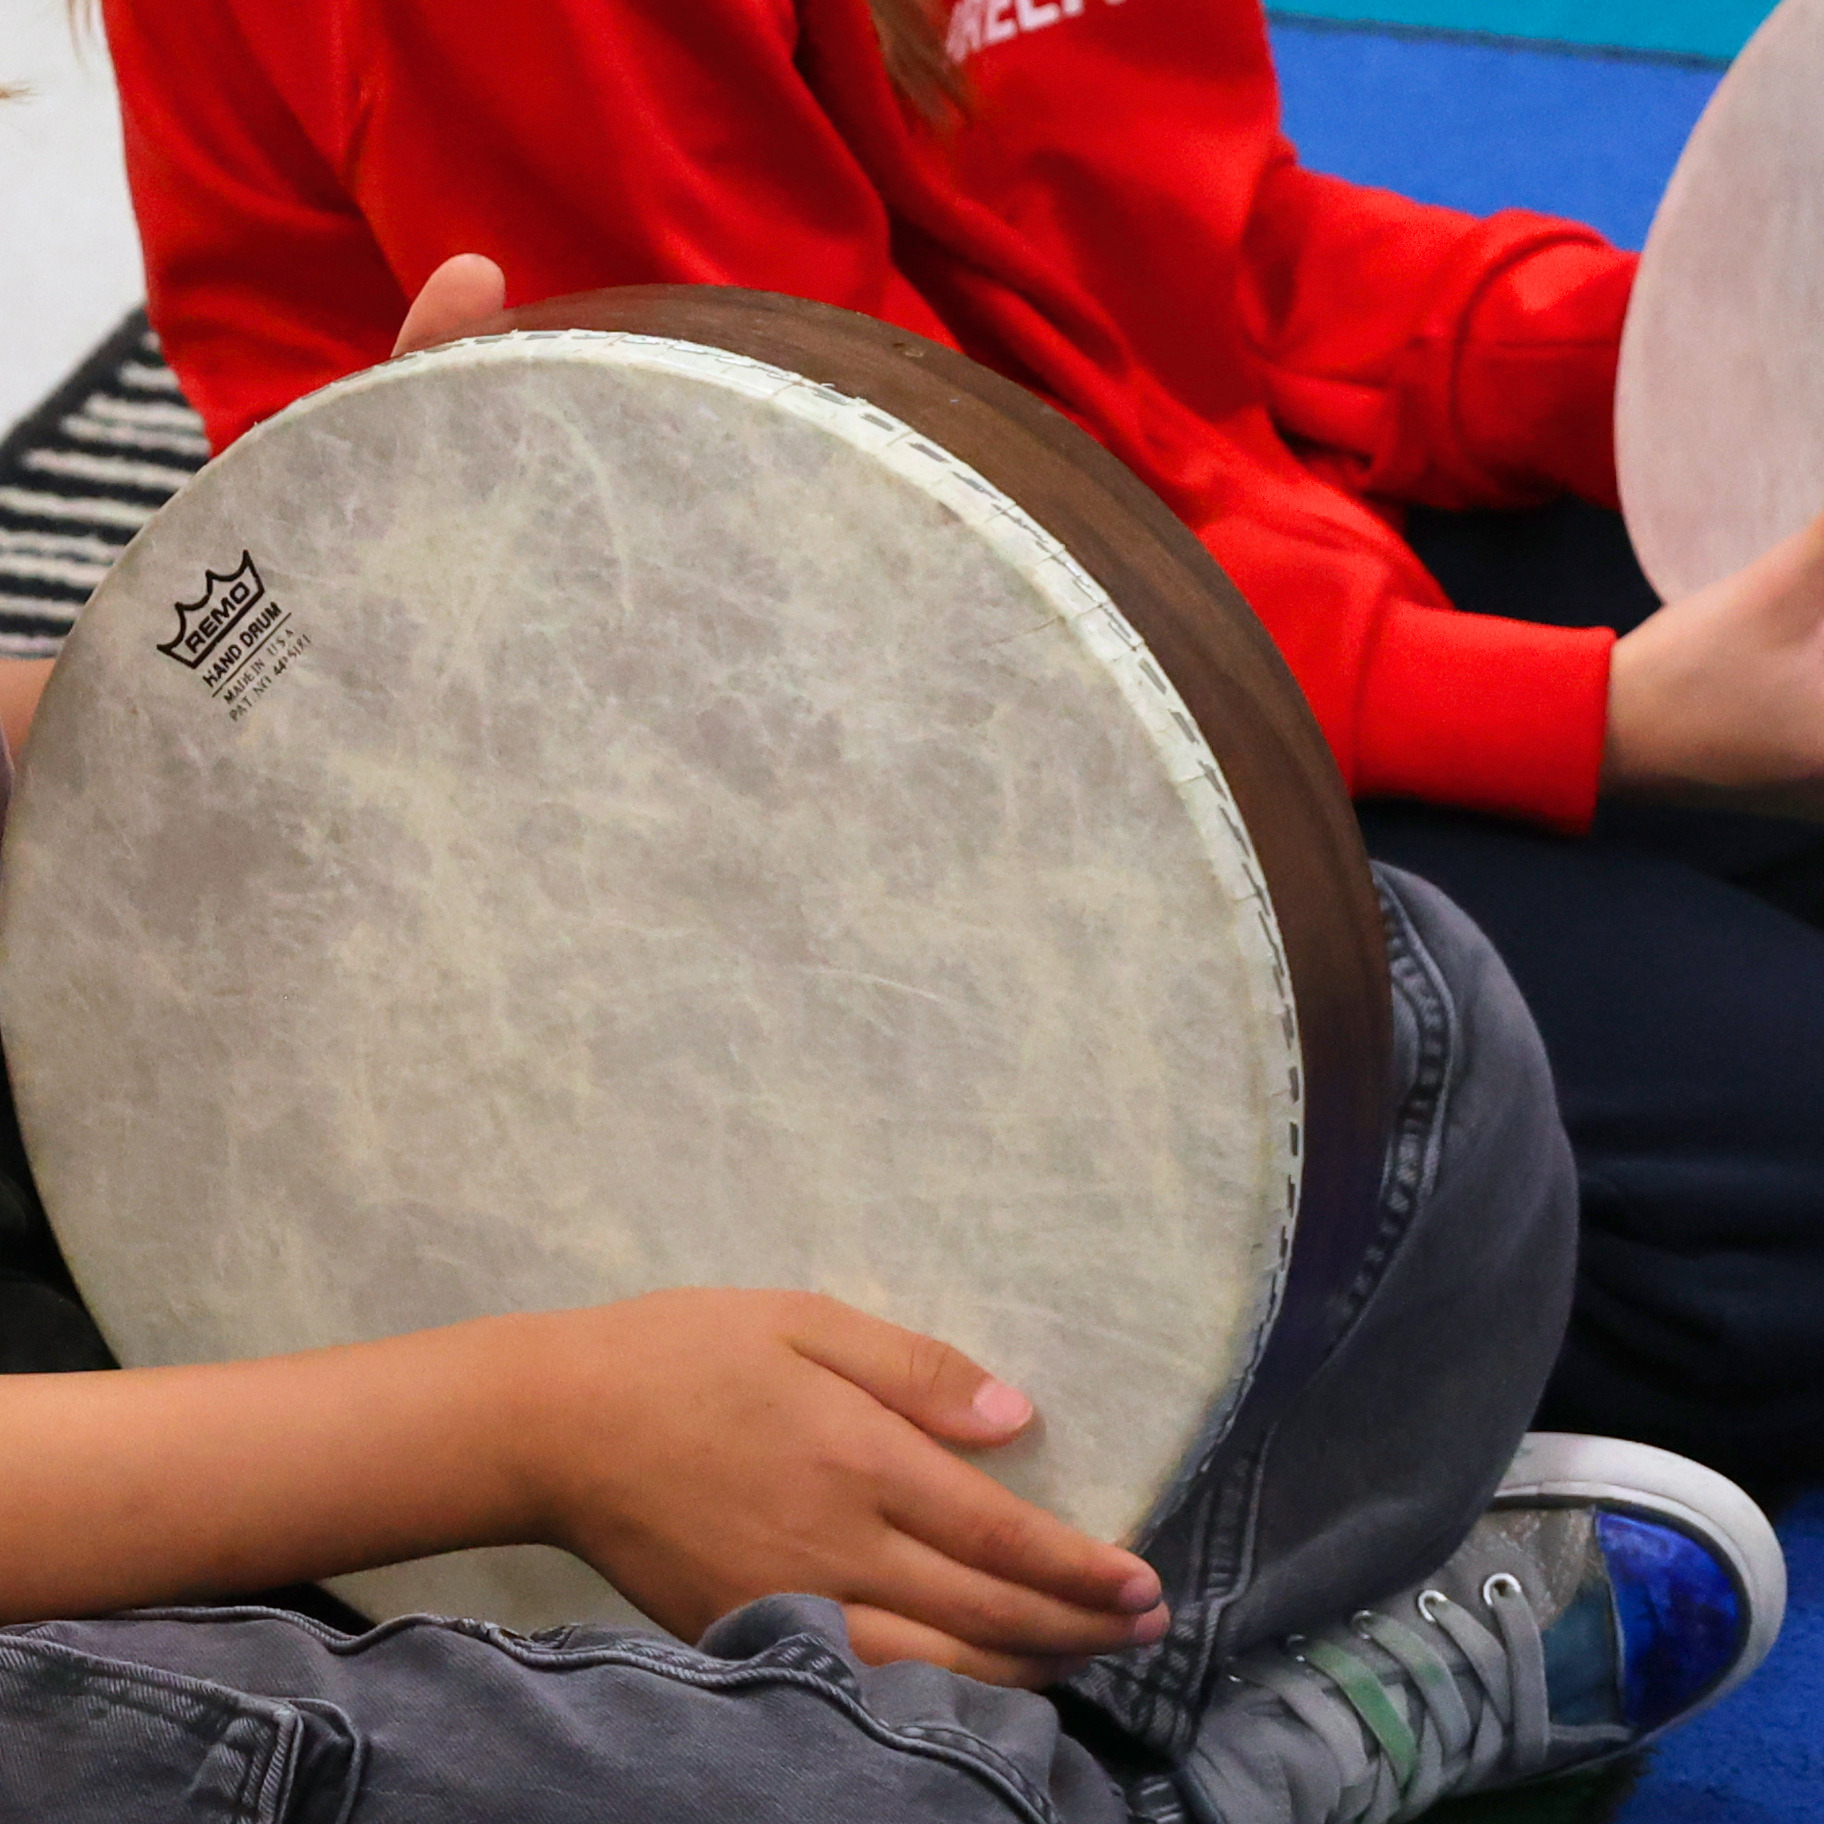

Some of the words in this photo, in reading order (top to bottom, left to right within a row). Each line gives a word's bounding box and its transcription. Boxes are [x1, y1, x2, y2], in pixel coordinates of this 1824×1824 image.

[184, 580, 251, 654] REMO
[202, 644, 243, 688] HAND
[239, 601, 283, 648] DRUM
[223, 670, 255, 704] MADE
